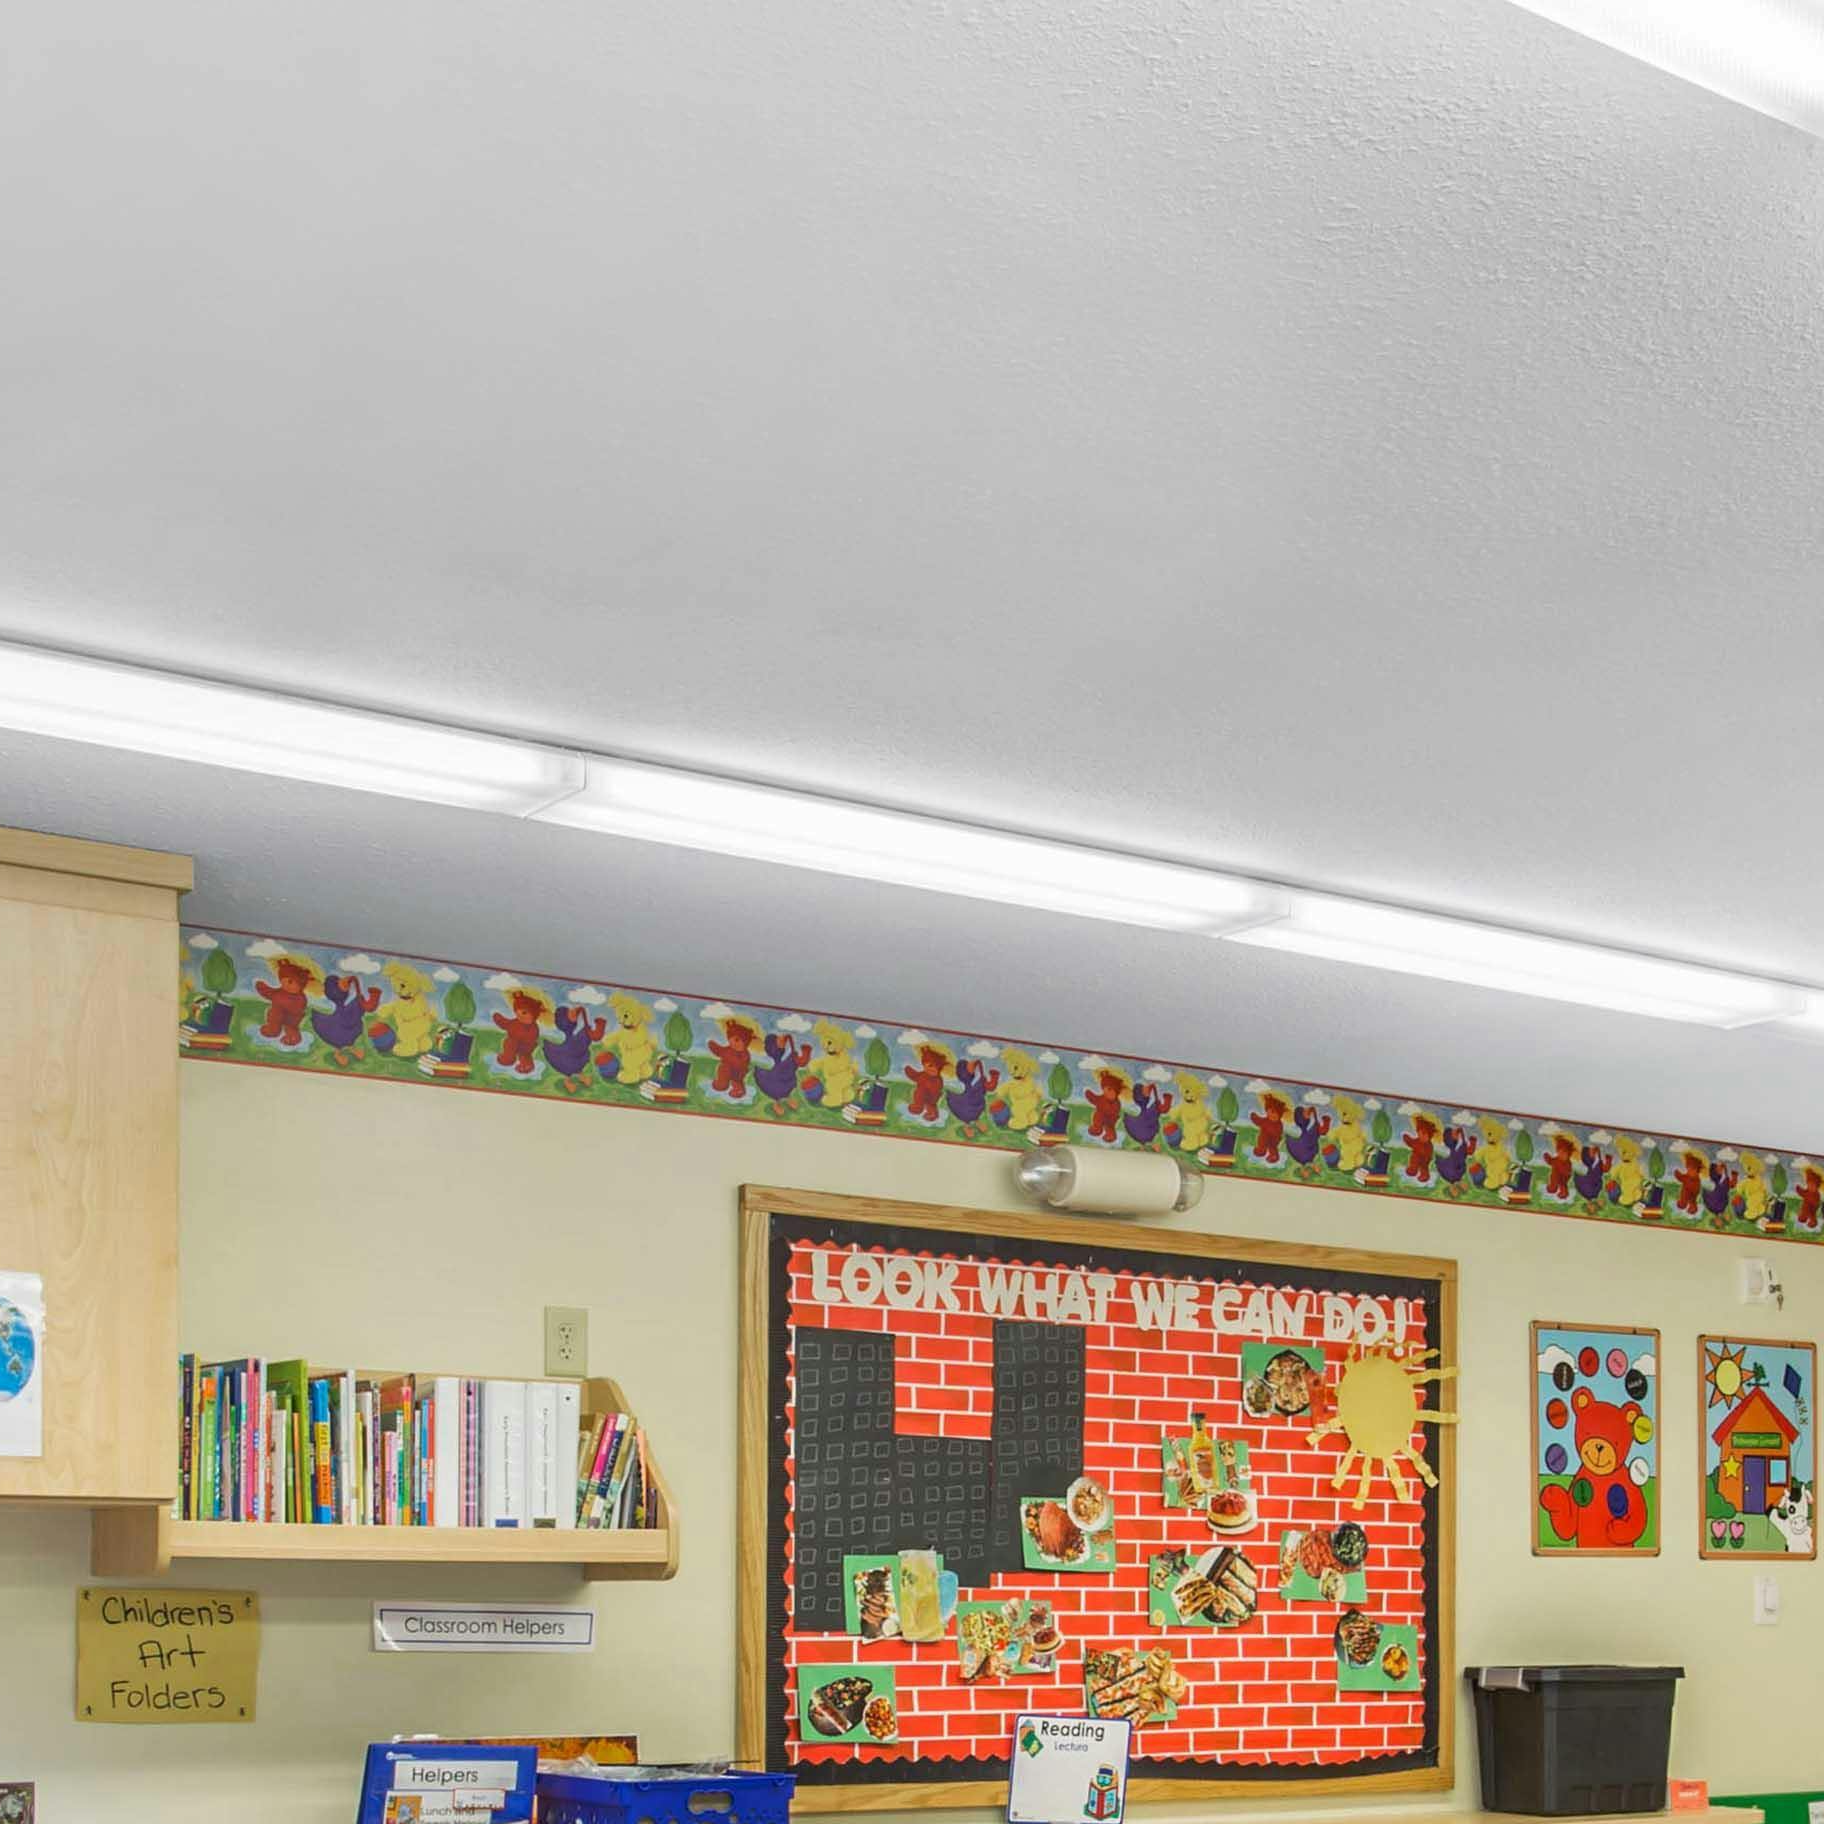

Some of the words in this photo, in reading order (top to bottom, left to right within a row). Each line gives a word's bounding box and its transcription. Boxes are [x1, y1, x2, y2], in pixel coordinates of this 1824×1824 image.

[809, 1252, 960, 1311] LOOK
[978, 1265, 1117, 1323] WHAT
[1132, 1279, 1201, 1332] WE
[1211, 1287, 1305, 1339] CAN
[1324, 1294, 1408, 1346] DO!
[102, 1596, 235, 1627] Children's
[404, 1616, 498, 1634] Classroom
[502, 1618, 566, 1638] Helpers
[138, 1634, 207, 1670] Art
[110, 1680, 226, 1710] Folders
[1040, 1720, 1106, 1742] Reading
[411, 1768, 480, 1786] Helpers
